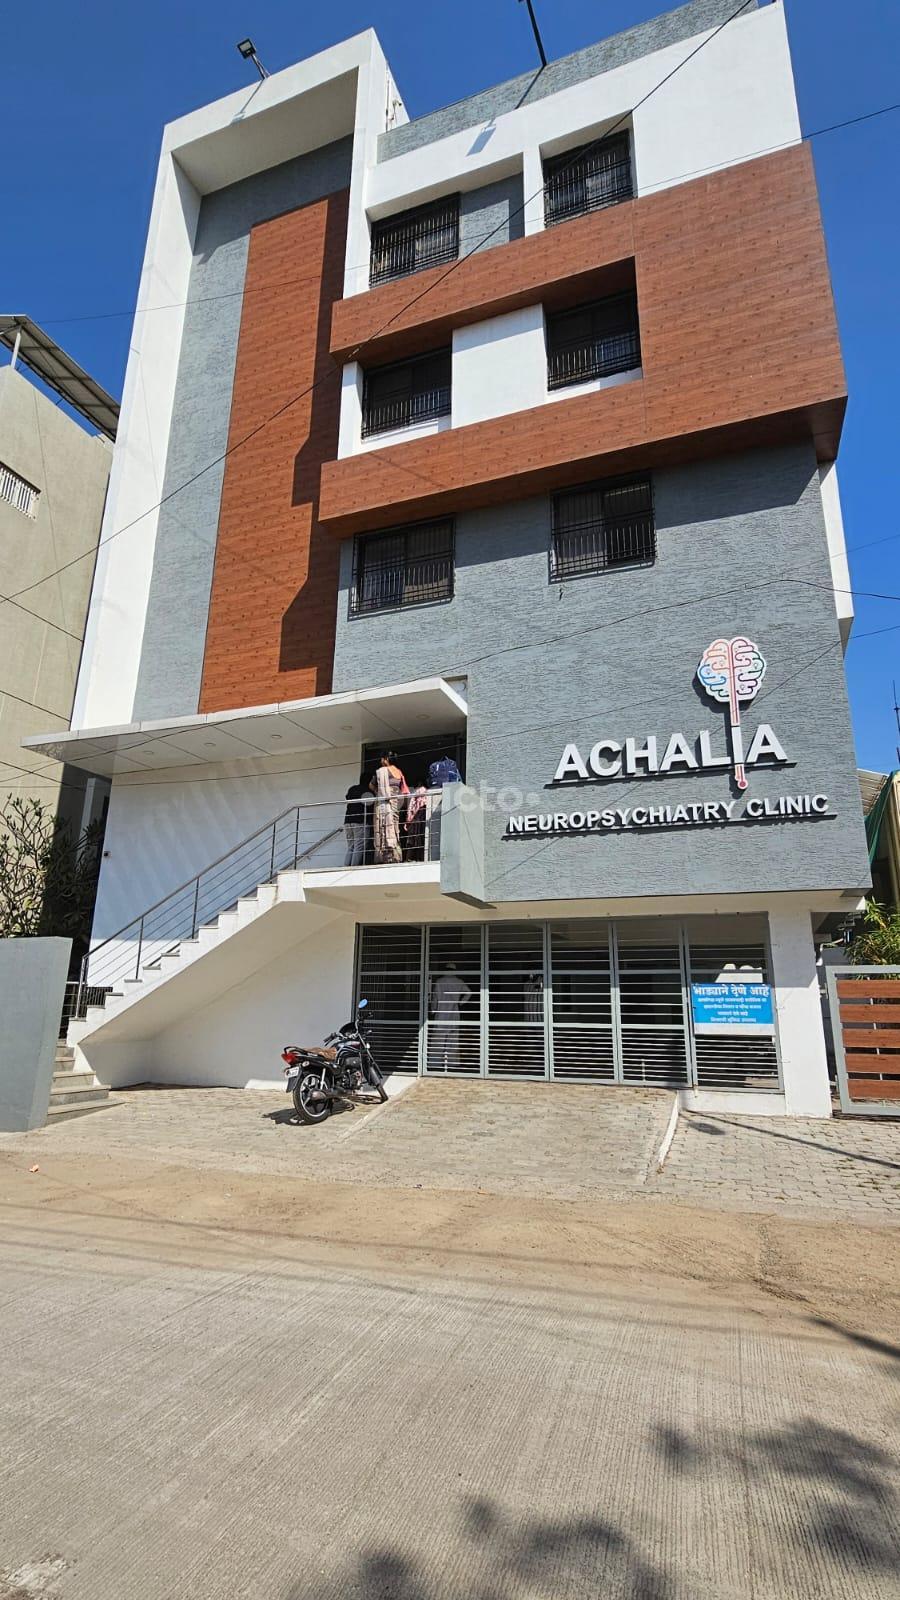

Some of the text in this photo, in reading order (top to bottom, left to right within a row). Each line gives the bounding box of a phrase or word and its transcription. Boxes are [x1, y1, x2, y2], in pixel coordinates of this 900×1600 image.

[554, 723, 788, 780] ACHALIA
[508, 794, 829, 833] NEUROPSYCHIATRY CLINIC
[750, 983, 770, 998] आहे
